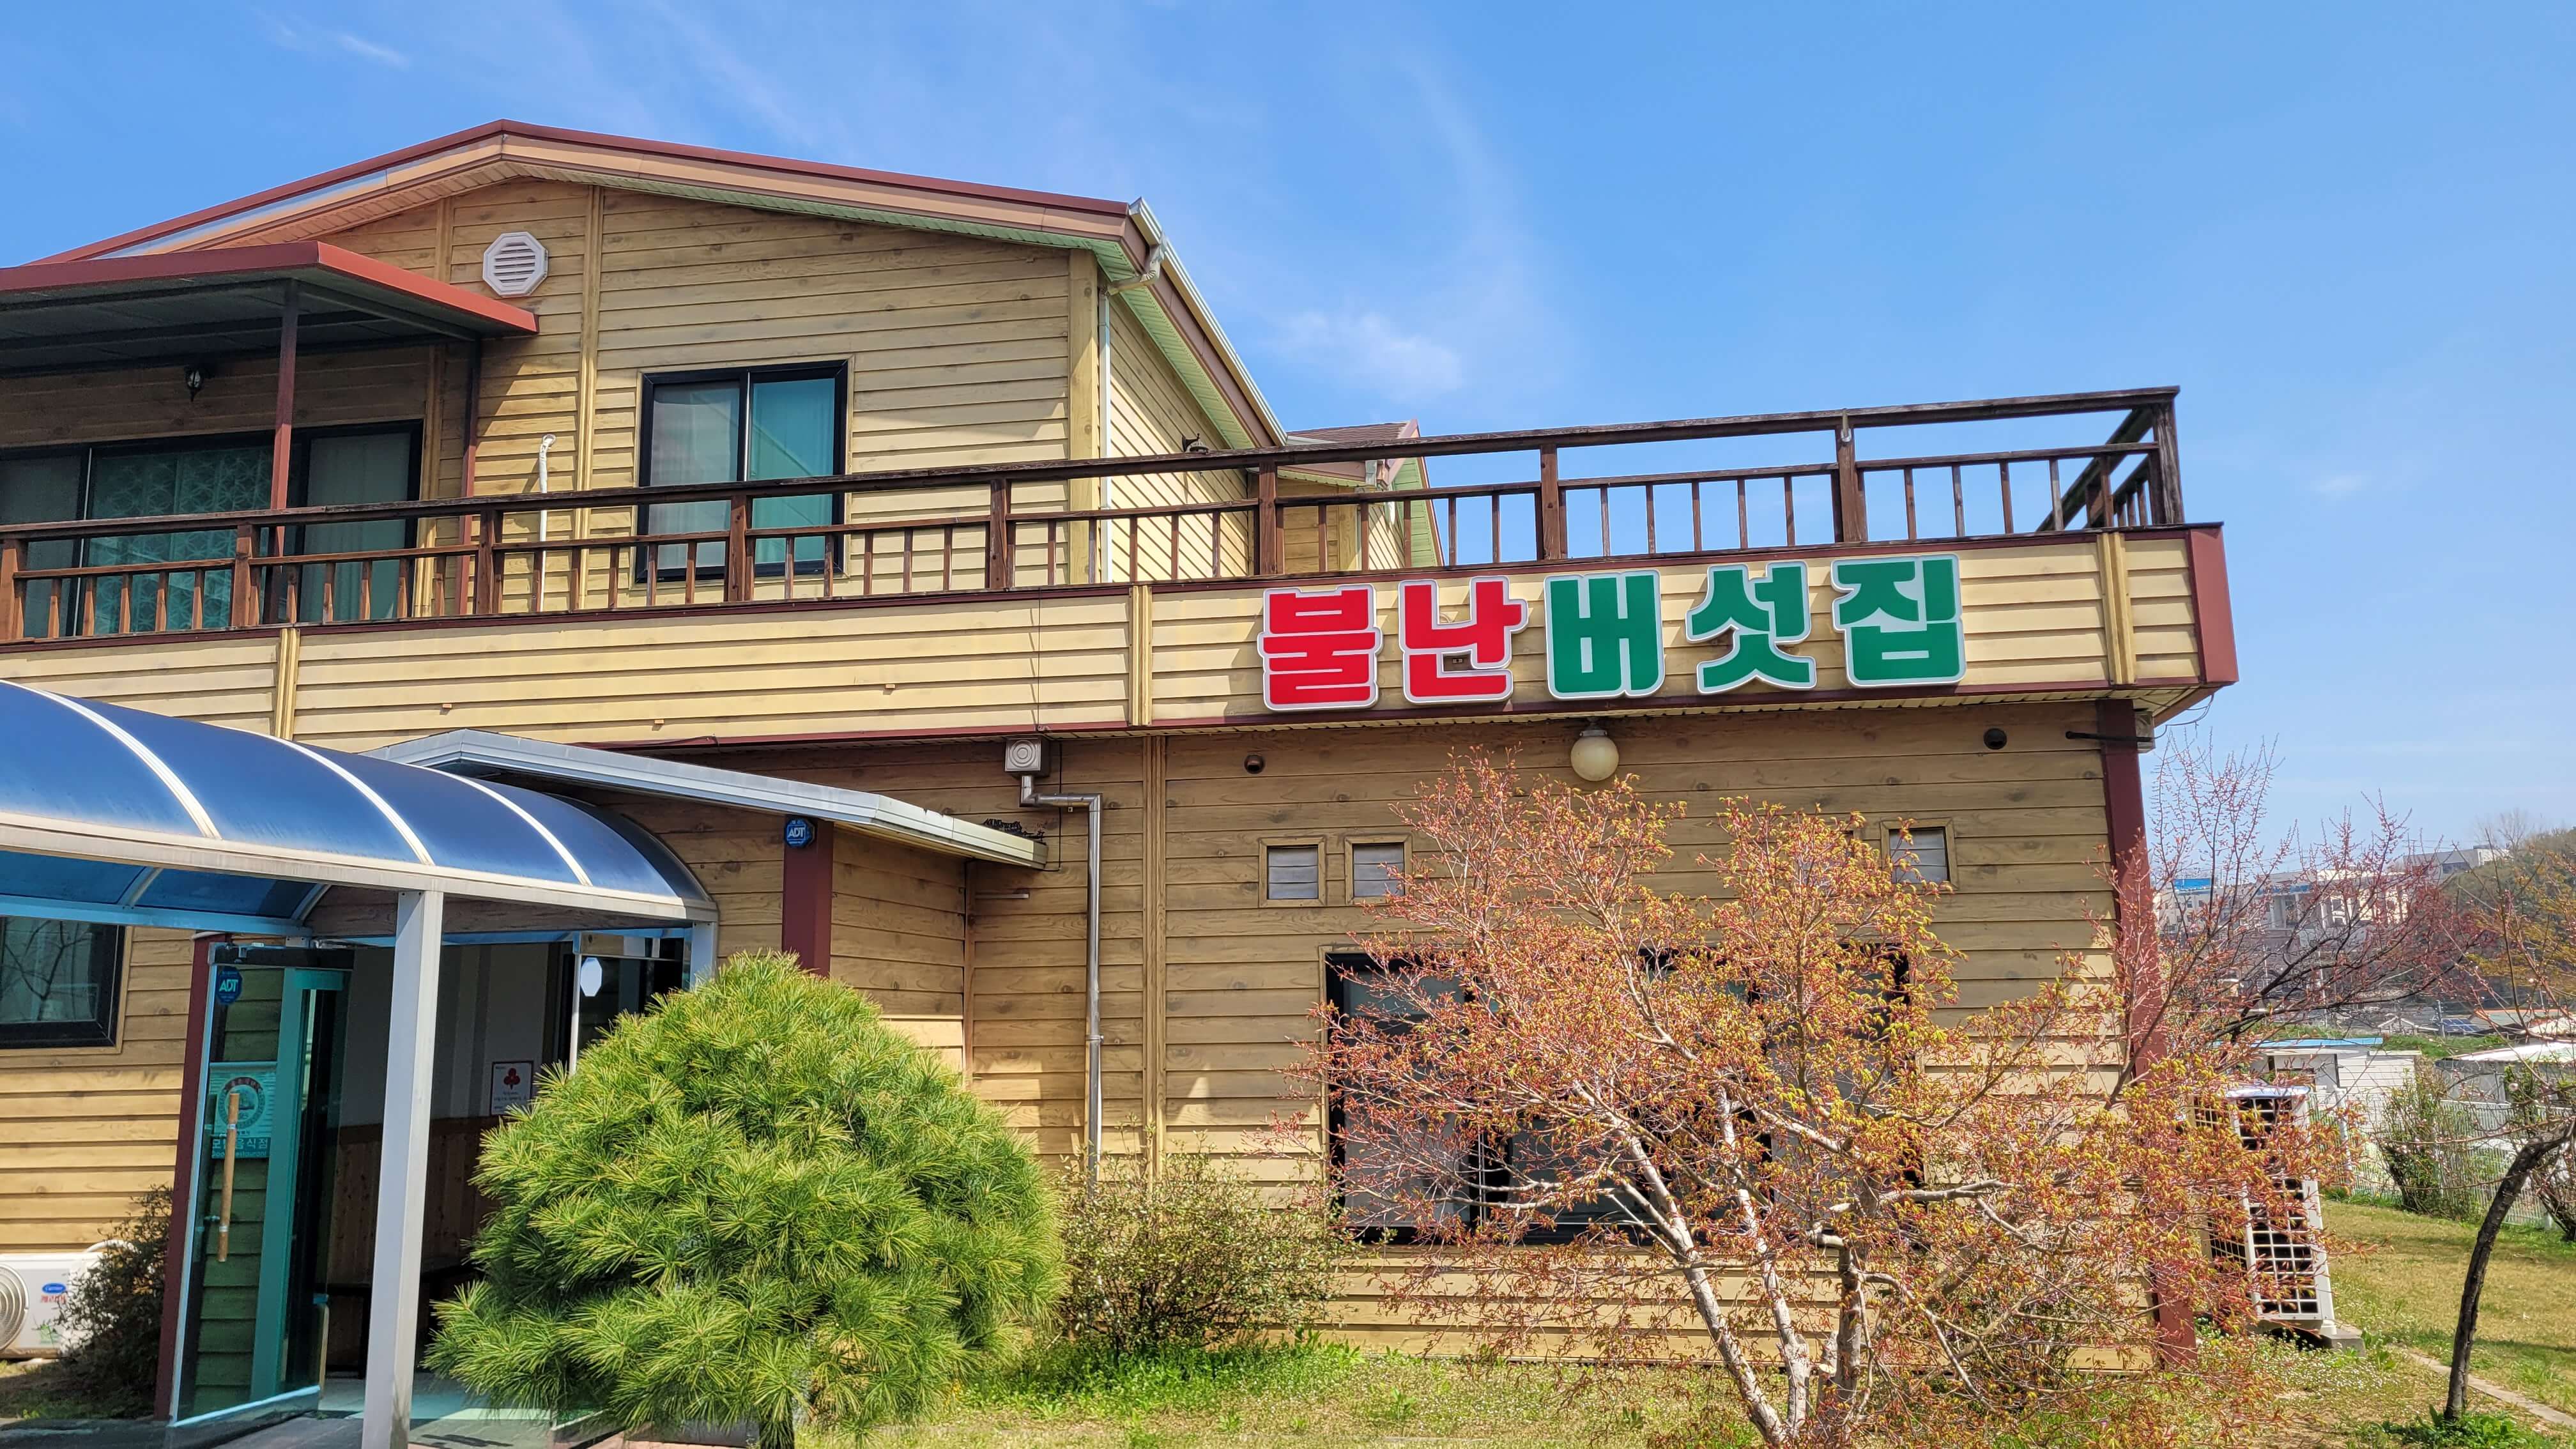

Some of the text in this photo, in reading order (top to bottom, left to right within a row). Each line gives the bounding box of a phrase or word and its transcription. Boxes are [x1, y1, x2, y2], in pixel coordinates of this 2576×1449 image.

[1259, 554, 1966, 710] 불난버섯집
[788, 827, 806, 838] ADT
[218, 979, 239, 992] ADT
[212, 1138, 268, 1149] 모음식점
